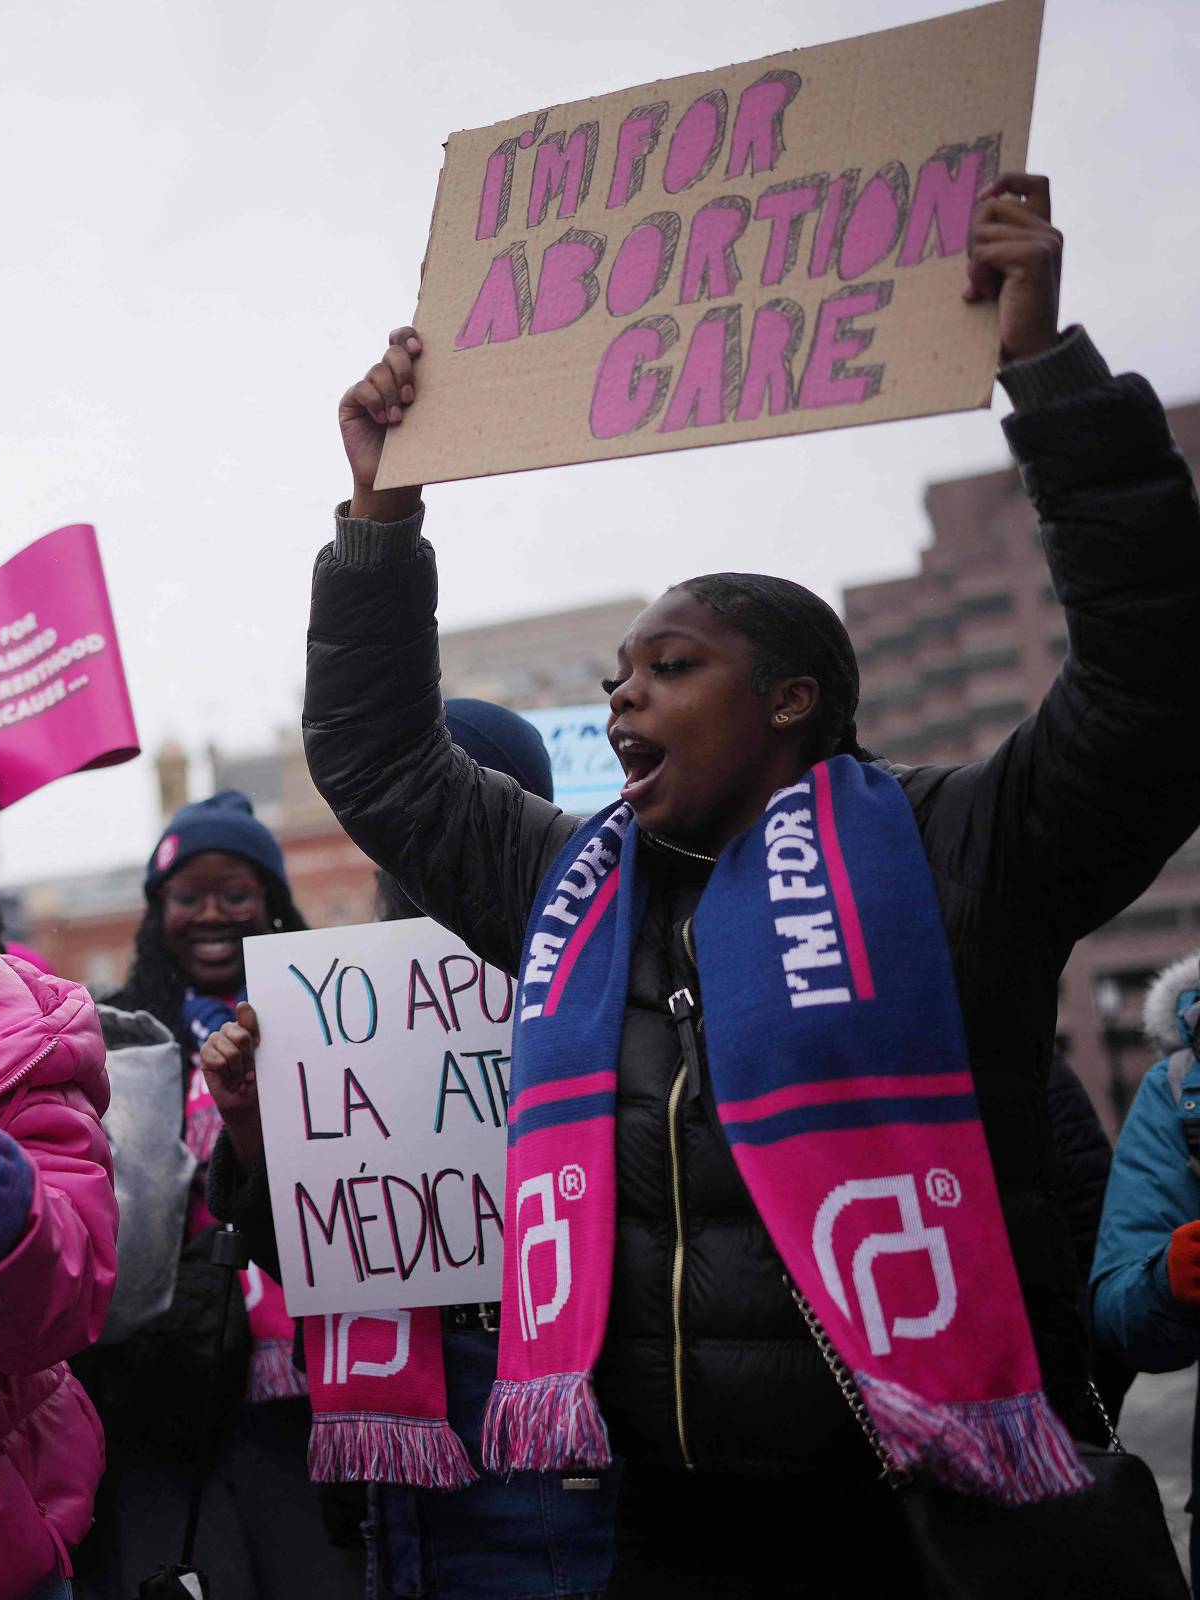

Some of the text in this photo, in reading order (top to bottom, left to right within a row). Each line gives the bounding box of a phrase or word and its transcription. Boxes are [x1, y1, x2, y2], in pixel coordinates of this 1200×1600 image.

[475, 70, 801, 240] I'M FOR
[453, 132, 1002, 352] ABORTION
[588, 279, 893, 440] CARE
[764, 807, 827, 902] FOR
[288, 958, 378, 1046] YO
[774, 910, 851, 1008] I'M
[297, 1061, 391, 1140] LA
[295, 1162, 504, 1287] MÉDICA
